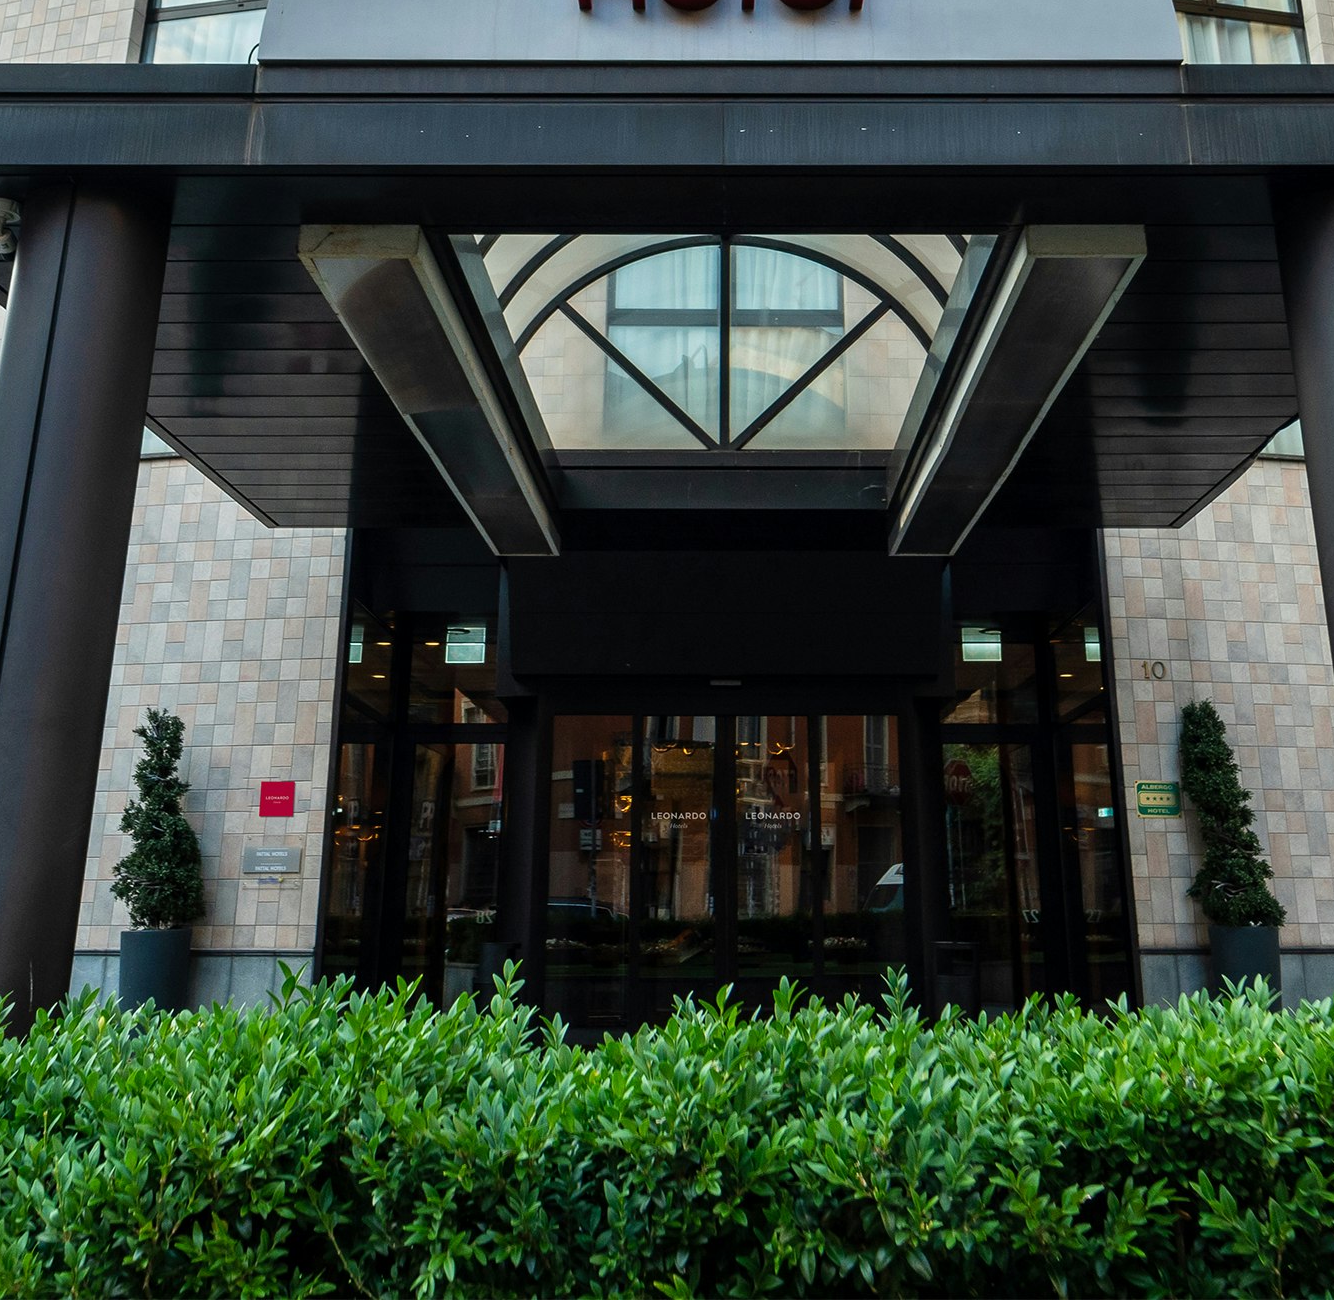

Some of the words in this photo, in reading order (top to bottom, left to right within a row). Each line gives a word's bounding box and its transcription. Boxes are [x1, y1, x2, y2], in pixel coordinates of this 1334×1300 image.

[1141, 661, 1166, 680] 10
[651, 812, 707, 820] LEONARDO
[745, 812, 801, 820] LEONARDO
